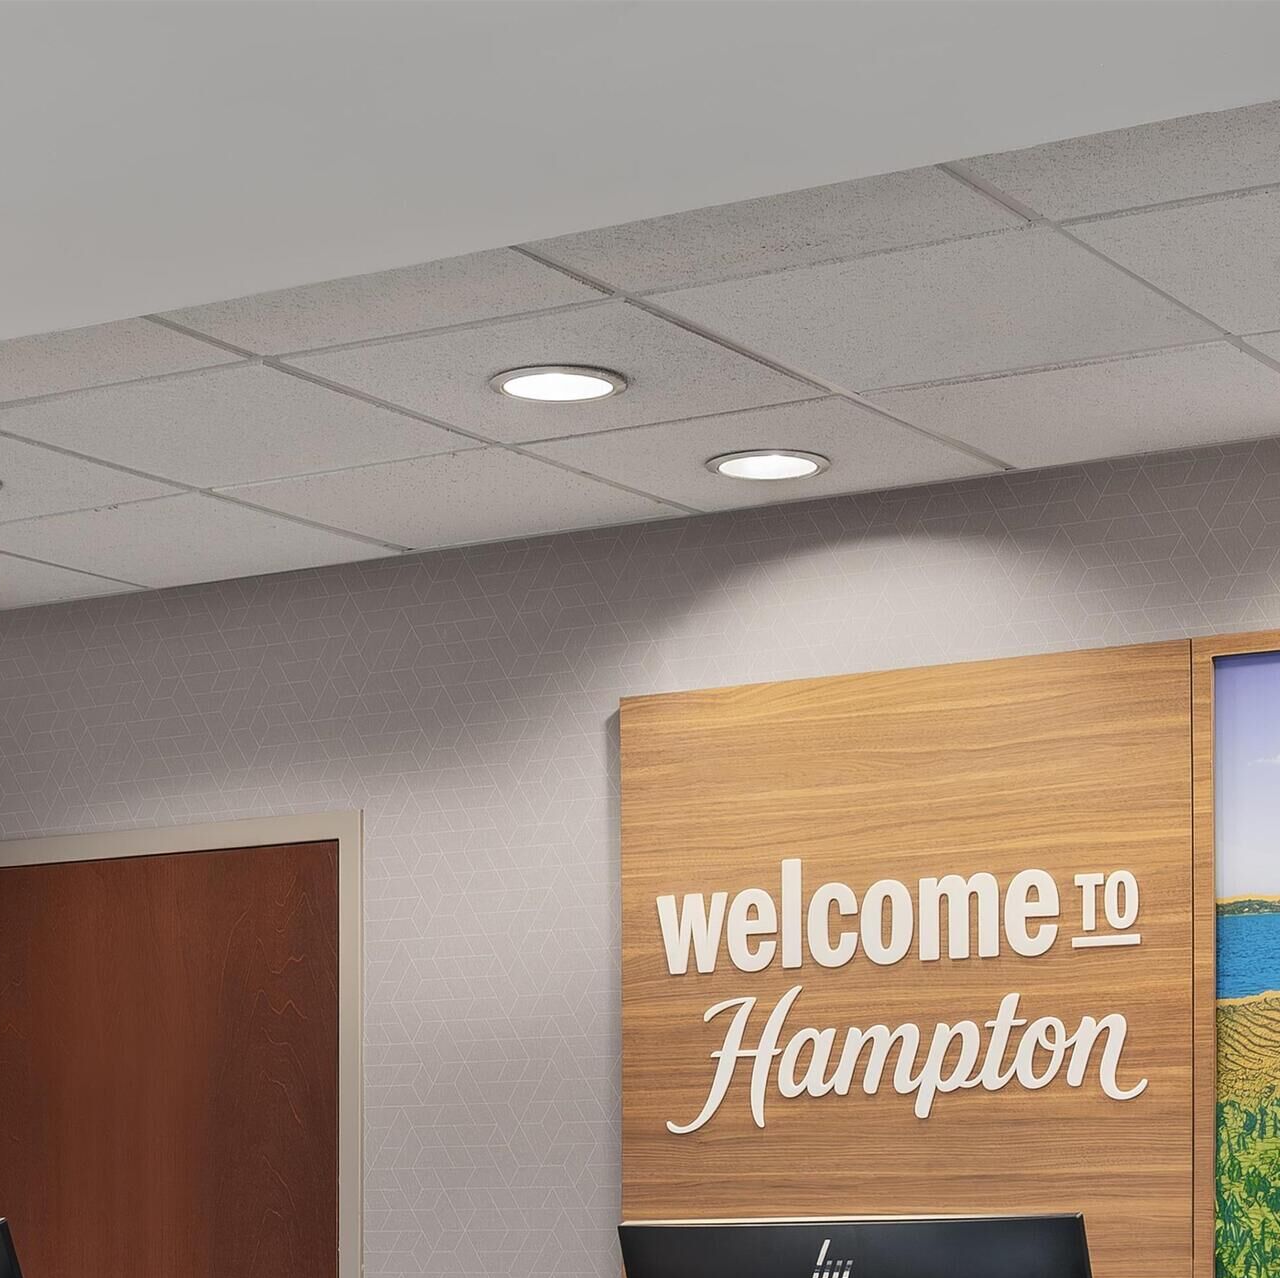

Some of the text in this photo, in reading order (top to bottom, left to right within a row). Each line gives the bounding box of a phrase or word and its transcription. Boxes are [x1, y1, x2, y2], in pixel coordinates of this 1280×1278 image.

[656, 858, 1140, 975] welcome TO
[666, 985, 1148, 1134] Hampton
